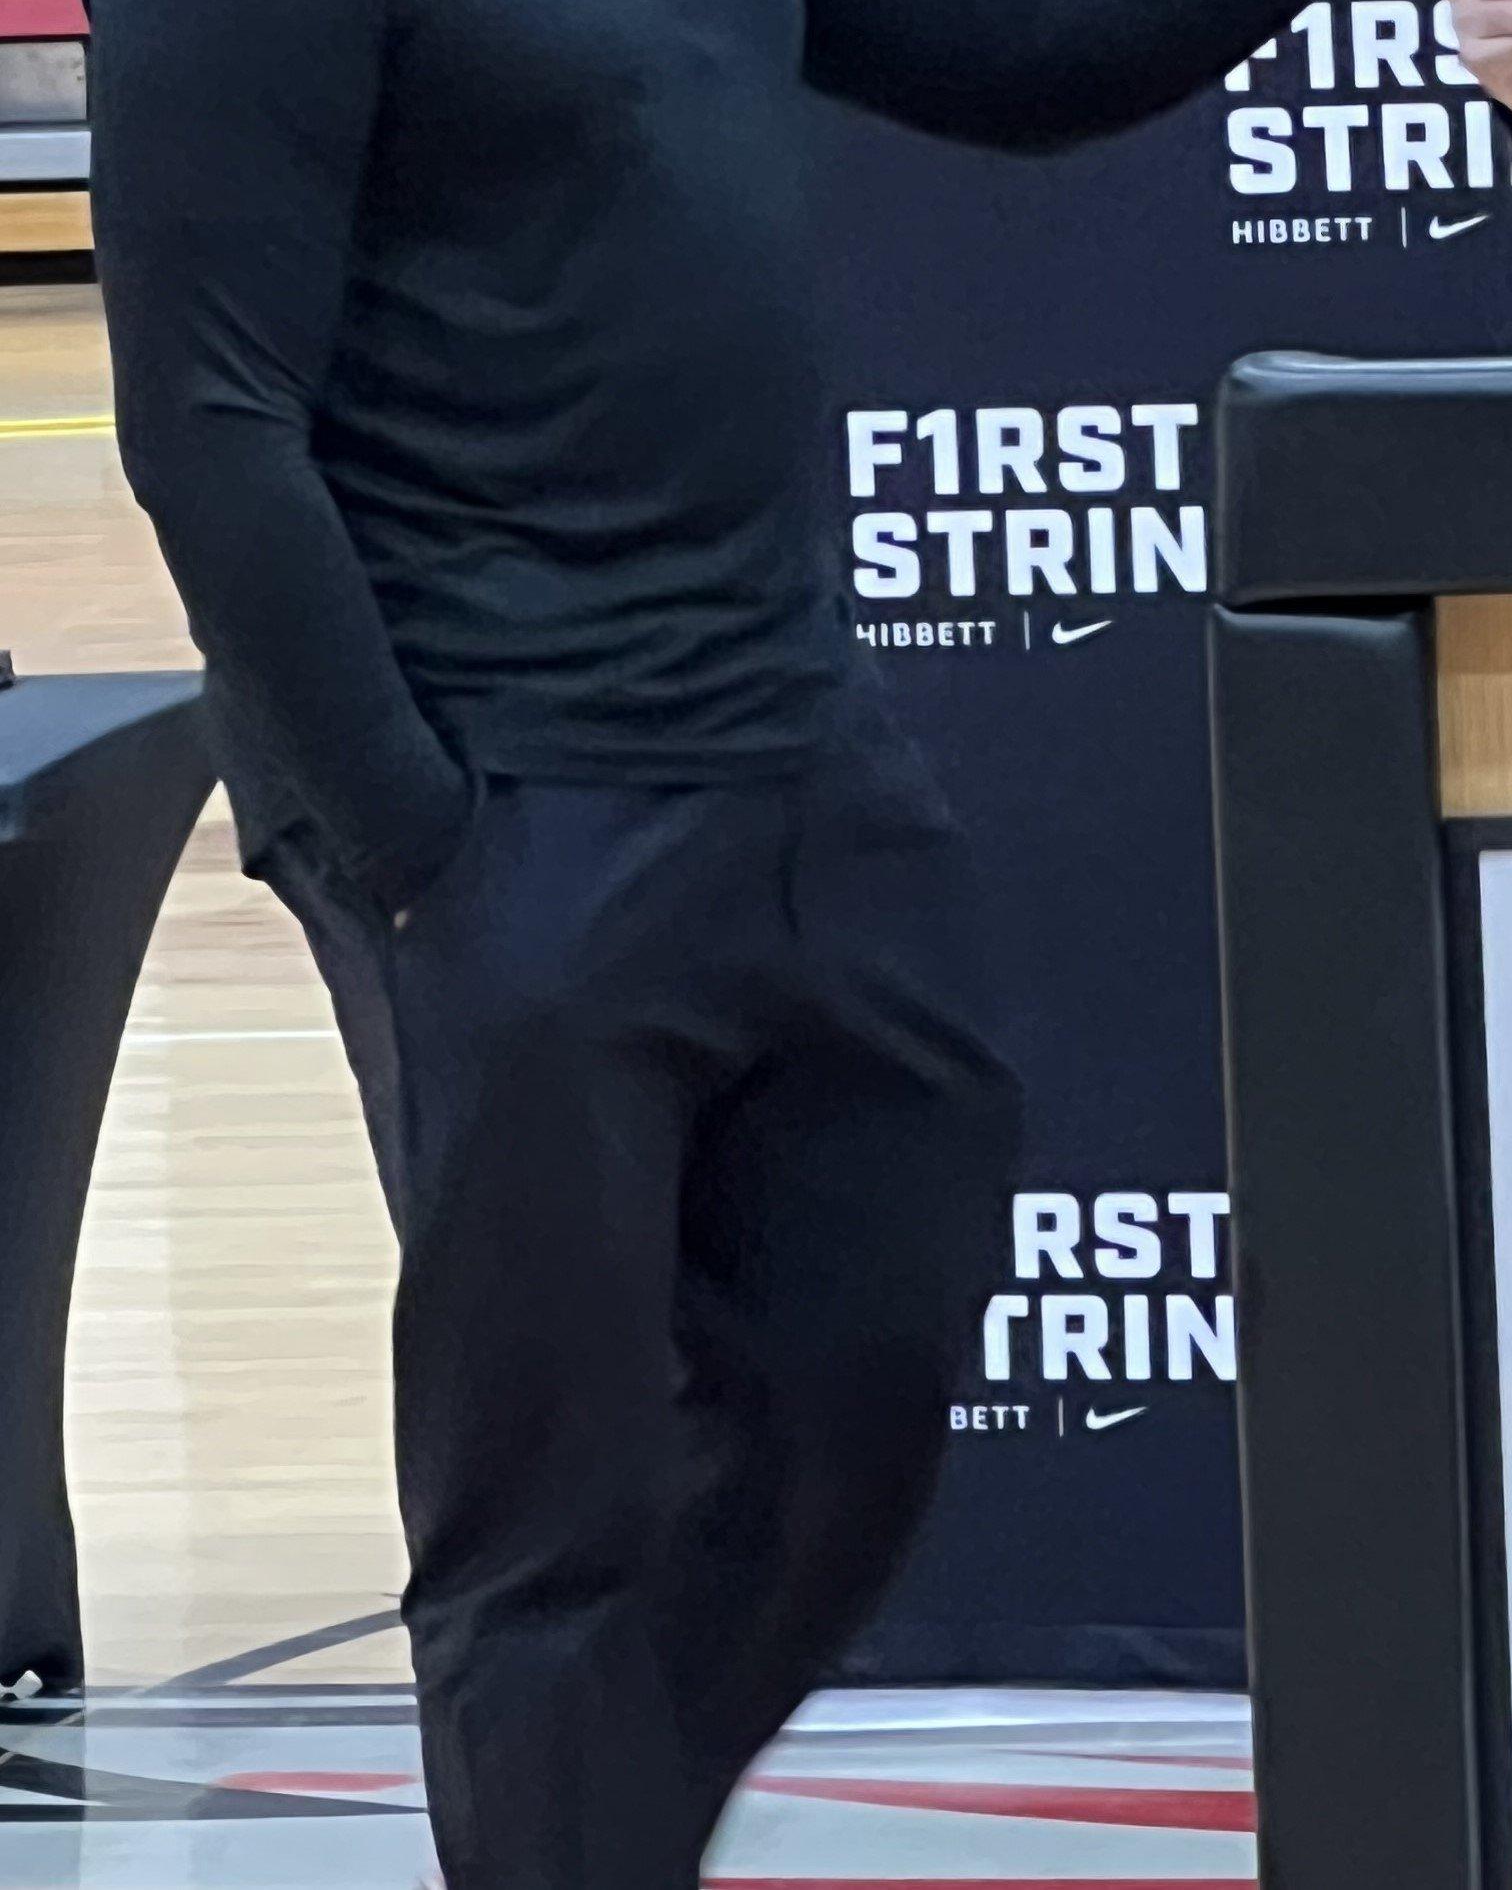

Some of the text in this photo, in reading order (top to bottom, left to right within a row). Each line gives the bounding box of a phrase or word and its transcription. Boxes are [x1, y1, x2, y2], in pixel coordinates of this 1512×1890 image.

[1232, 216, 1373, 244] HIBBETT
[846, 403, 1199, 497] F1RST
[852, 505, 1207, 599] STRIN
[856, 621, 996, 647] HIBBETT
[1012, 1192, 1231, 1279] RST
[983, 1294, 1237, 1381] TRIN
[950, 1405, 1030, 1430] BETT
